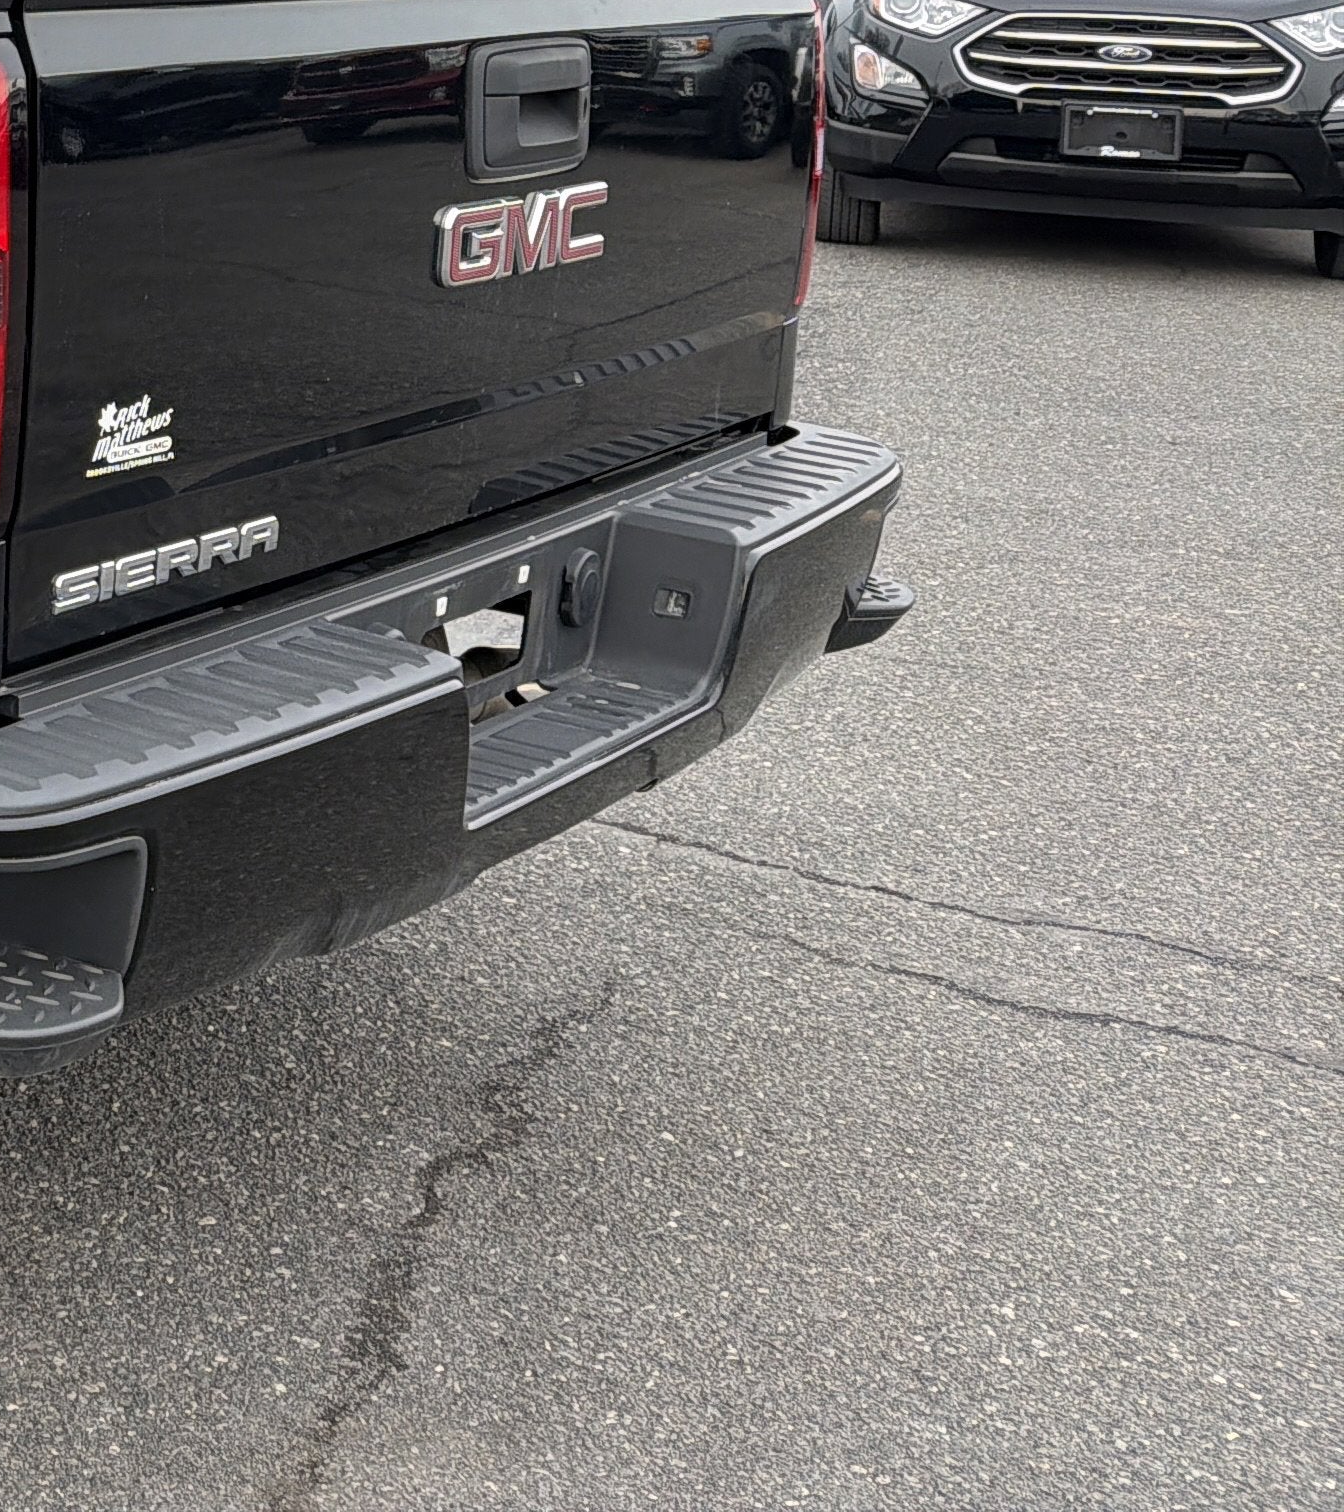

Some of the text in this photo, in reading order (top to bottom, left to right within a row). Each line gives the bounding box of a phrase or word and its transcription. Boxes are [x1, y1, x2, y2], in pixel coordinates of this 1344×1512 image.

[432, 181, 609, 288] GMC
[111, 440, 169, 459] BUICK GMC
[52, 515, 279, 615] SIERRA
